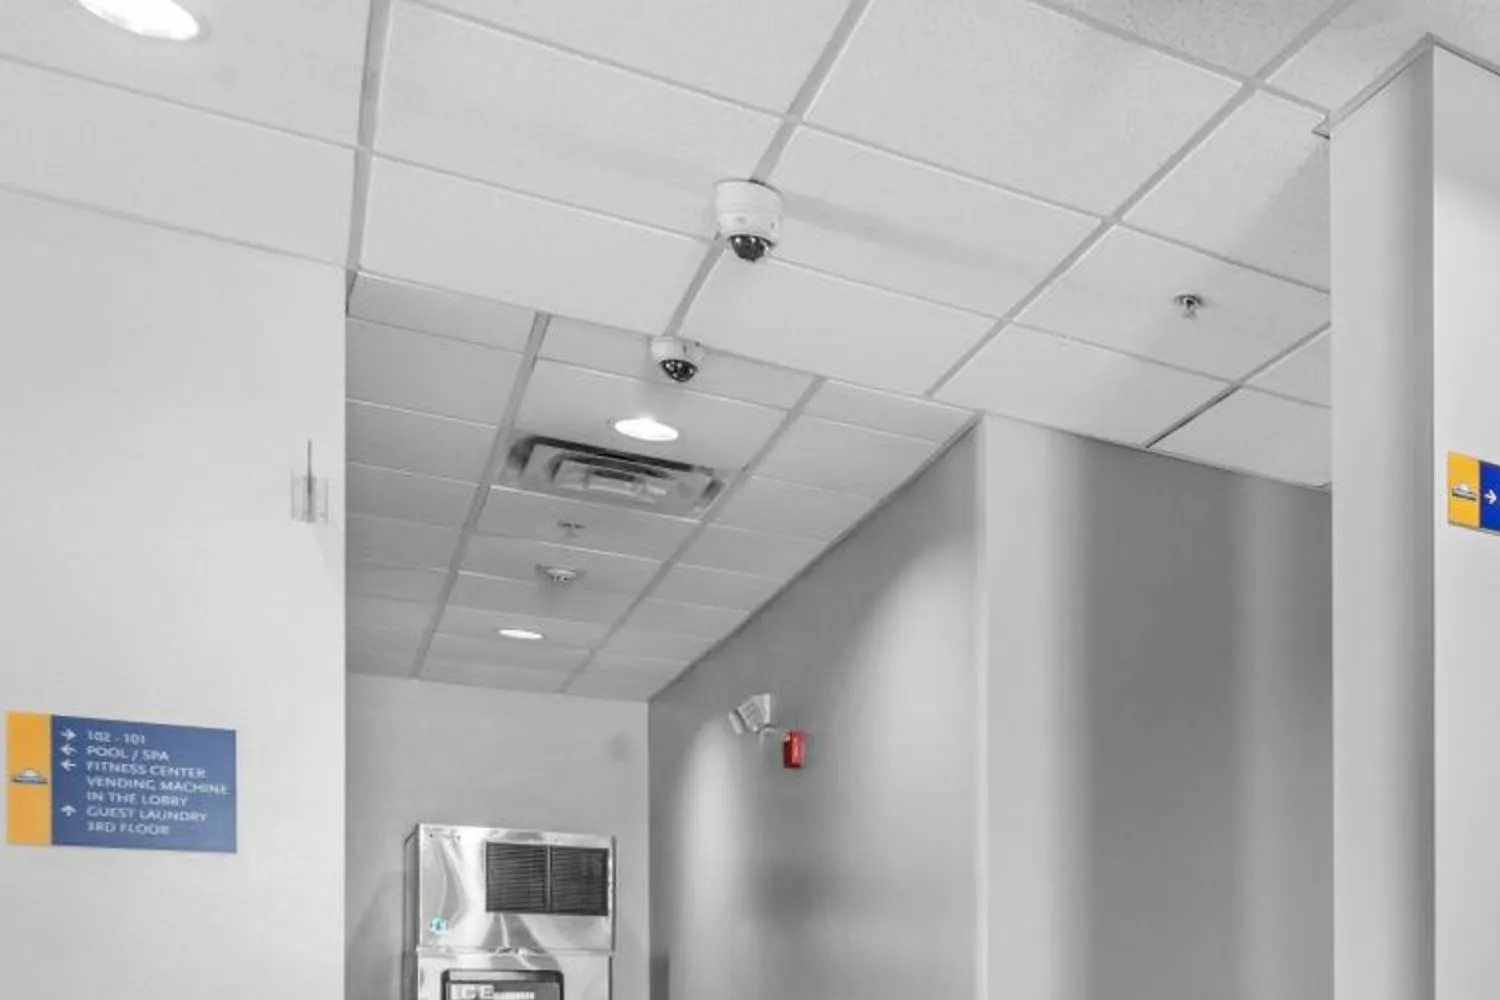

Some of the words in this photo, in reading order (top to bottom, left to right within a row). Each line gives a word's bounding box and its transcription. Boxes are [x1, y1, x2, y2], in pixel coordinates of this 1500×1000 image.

[87, 729, 111, 742] 102
[124, 733, 146, 745] 101
[86, 745, 129, 759] POOL
[131, 748, 139, 761] /
[142, 749, 169, 761] SPA
[86, 761, 147, 775] FITNESS
[149, 765, 207, 779] CENTER
[86, 777, 156, 791] VENDING
[160, 781, 230, 795] MACHINE
[87, 791, 103, 802] IN
[108, 792, 136, 804] THE
[141, 794, 188, 807] LOBBY
[86, 805, 135, 818] GUEST
[140, 809, 208, 822] LAUNDRY
[87, 821, 117, 833] 3RD
[119, 822, 170, 835] FLOOR
[451, 984, 493, 1000] ICE
